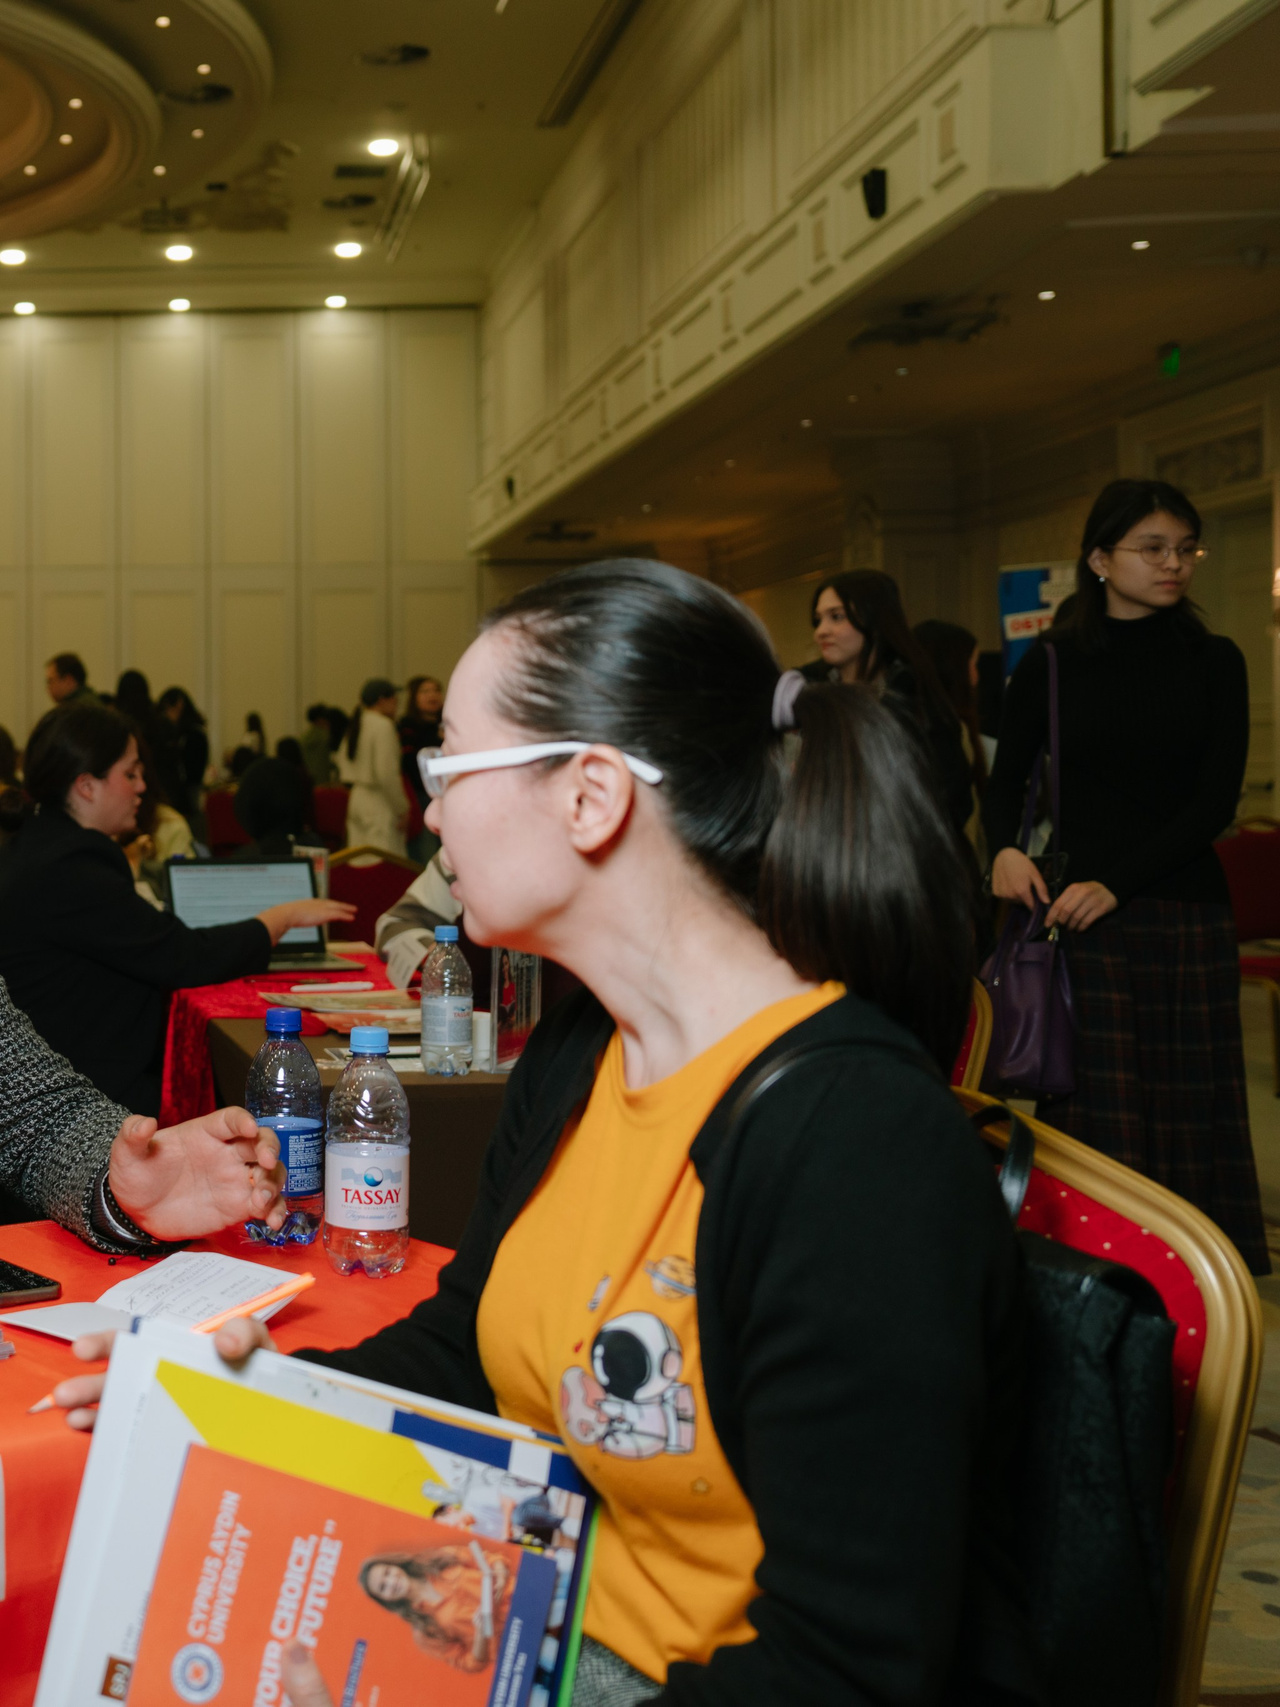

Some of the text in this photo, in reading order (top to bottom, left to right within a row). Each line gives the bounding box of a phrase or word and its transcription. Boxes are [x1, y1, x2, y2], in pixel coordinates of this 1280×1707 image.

[341, 1187, 402, 1205] TASSAY
[187, 1489, 242, 1639] CYPRUS AYDIN
[206, 1522, 253, 1645] UNIVERSITY
